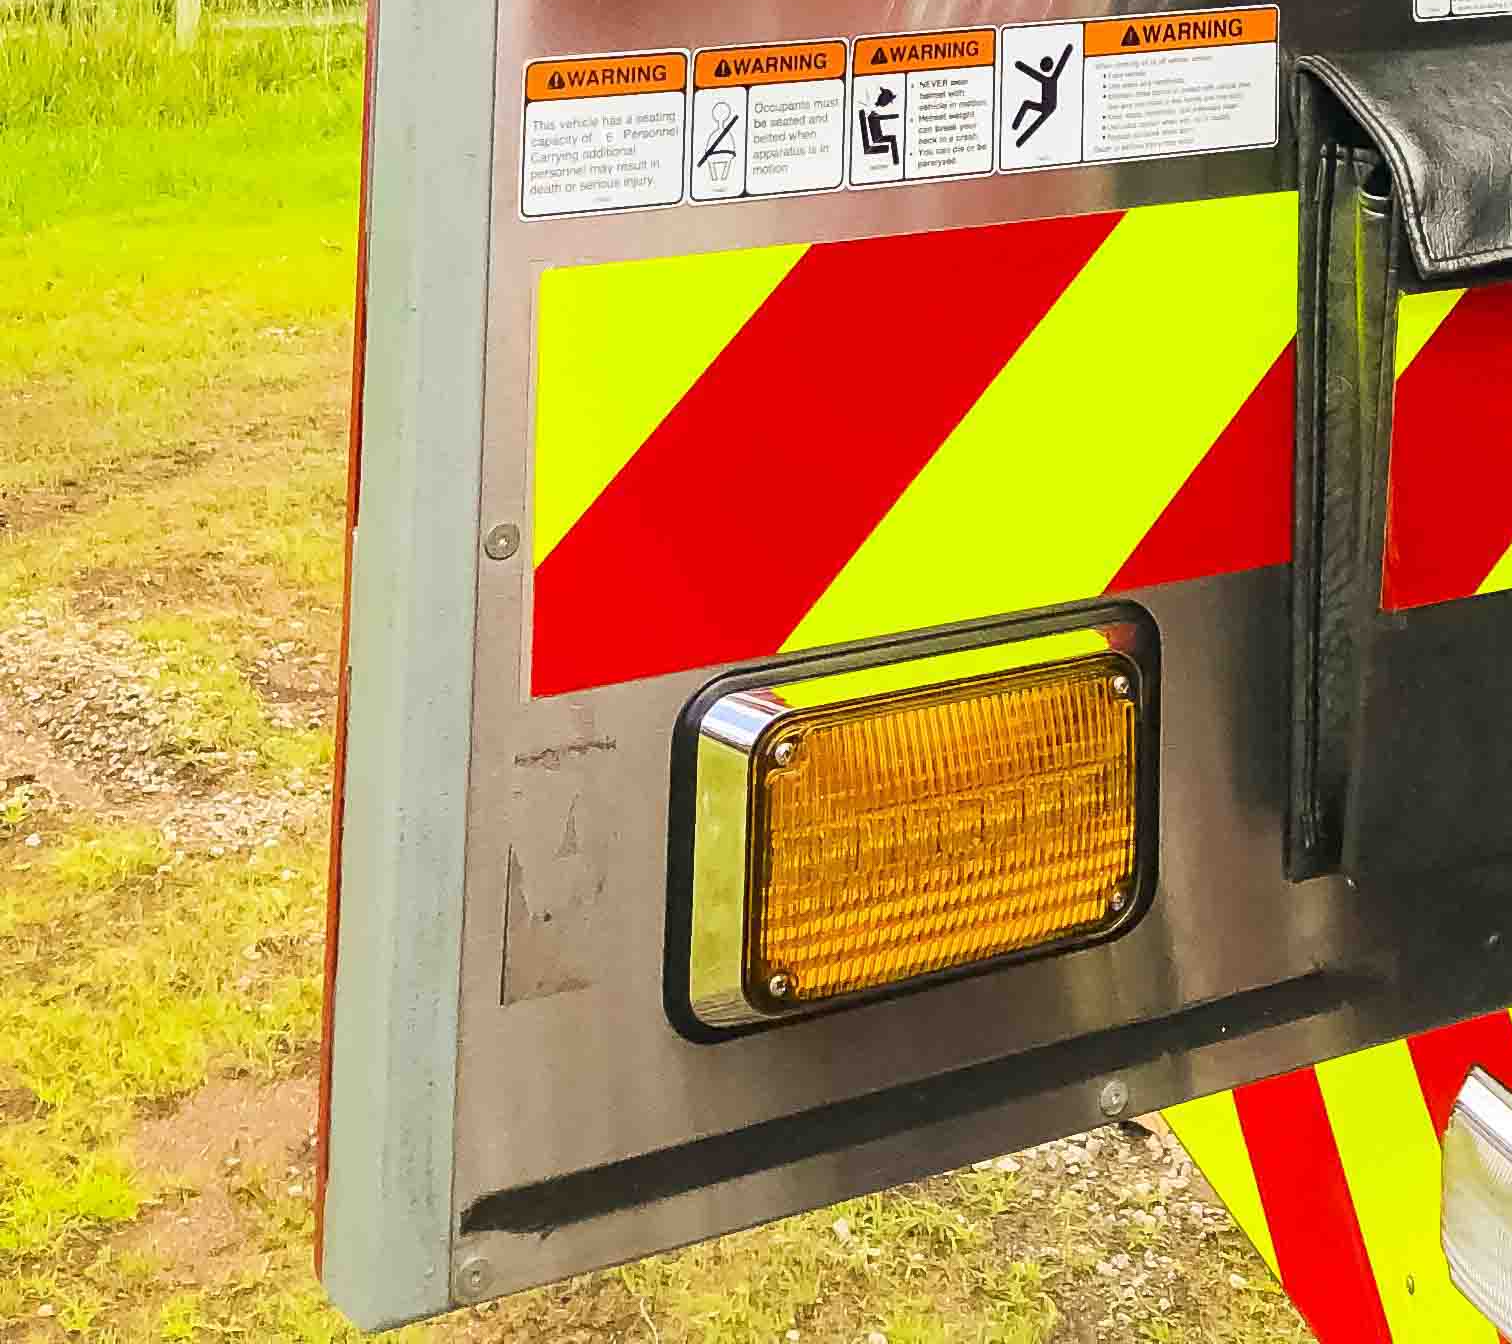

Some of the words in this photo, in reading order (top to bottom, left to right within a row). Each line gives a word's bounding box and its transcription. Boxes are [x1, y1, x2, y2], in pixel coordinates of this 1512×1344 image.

[1143, 18, 1243, 43] WARNING
[890, 41, 979, 63] WARNING
[733, 53, 827, 75] WARNING
[567, 65, 667, 87] WARNING
[919, 80, 947, 89] NEVER
[754, 100, 810, 114] Occupants
[813, 97, 839, 108] must
[532, 120, 555, 131] This
[559, 117, 599, 129] vehicle
[602, 114, 622, 126] has
[635, 112, 676, 126] seating
[754, 119, 767, 129] be
[770, 114, 806, 127] seated
[808, 112, 828, 124] and
[531, 134, 578, 148] capacity
[581, 133, 592, 144] of
[623, 126, 679, 140] Personnel
[788, 129, 817, 141] when
[530, 151, 579, 165] Carrying
[582, 146, 636, 160] additional
[752, 147, 806, 161] apparatus
[808, 144, 817, 154] is
[820, 144, 829, 153] in
[529, 166, 586, 181] personnel
[589, 163, 613, 176] may
[616, 159, 647, 172] result
[650, 159, 660, 169] in
[529, 182, 562, 195] death
[564, 182, 576, 193] or
[579, 179, 620, 192] serious
[623, 175, 655, 189] injury.
